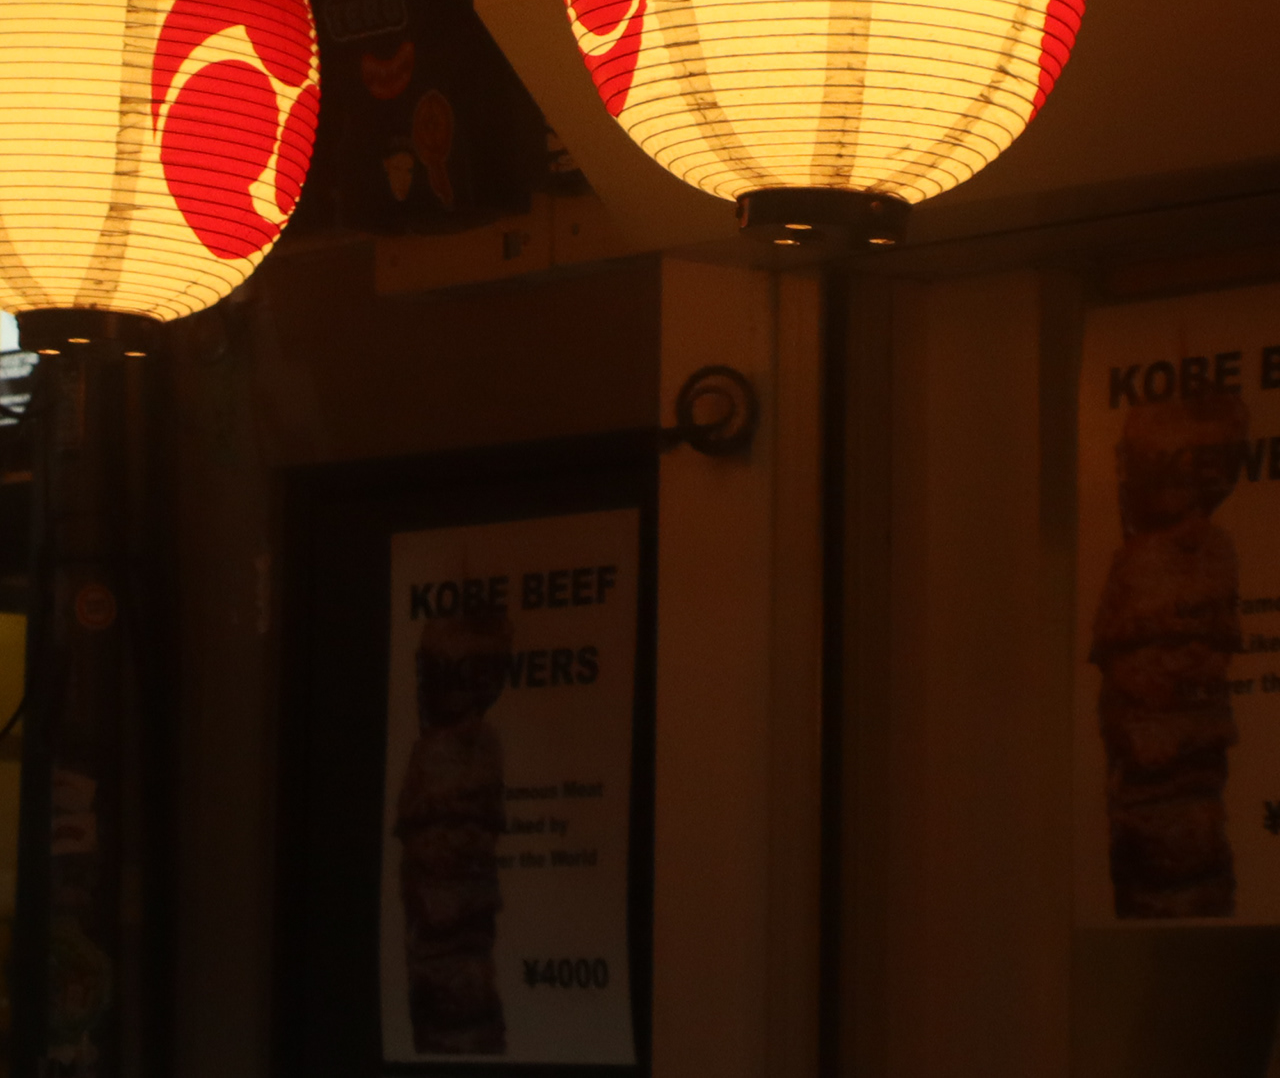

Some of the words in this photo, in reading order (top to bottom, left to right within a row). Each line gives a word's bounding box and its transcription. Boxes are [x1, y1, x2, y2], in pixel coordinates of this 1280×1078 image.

[1108, 350, 1243, 409] KOBE
[410, 575, 509, 620] KOBE
[521, 565, 618, 610] BEEF
[563, 780, 603, 798] Meat
[549, 815, 569, 837] by
[519, 851, 545, 868] the
[551, 848, 598, 867] World
[523, 956, 610, 990] ¥4000
